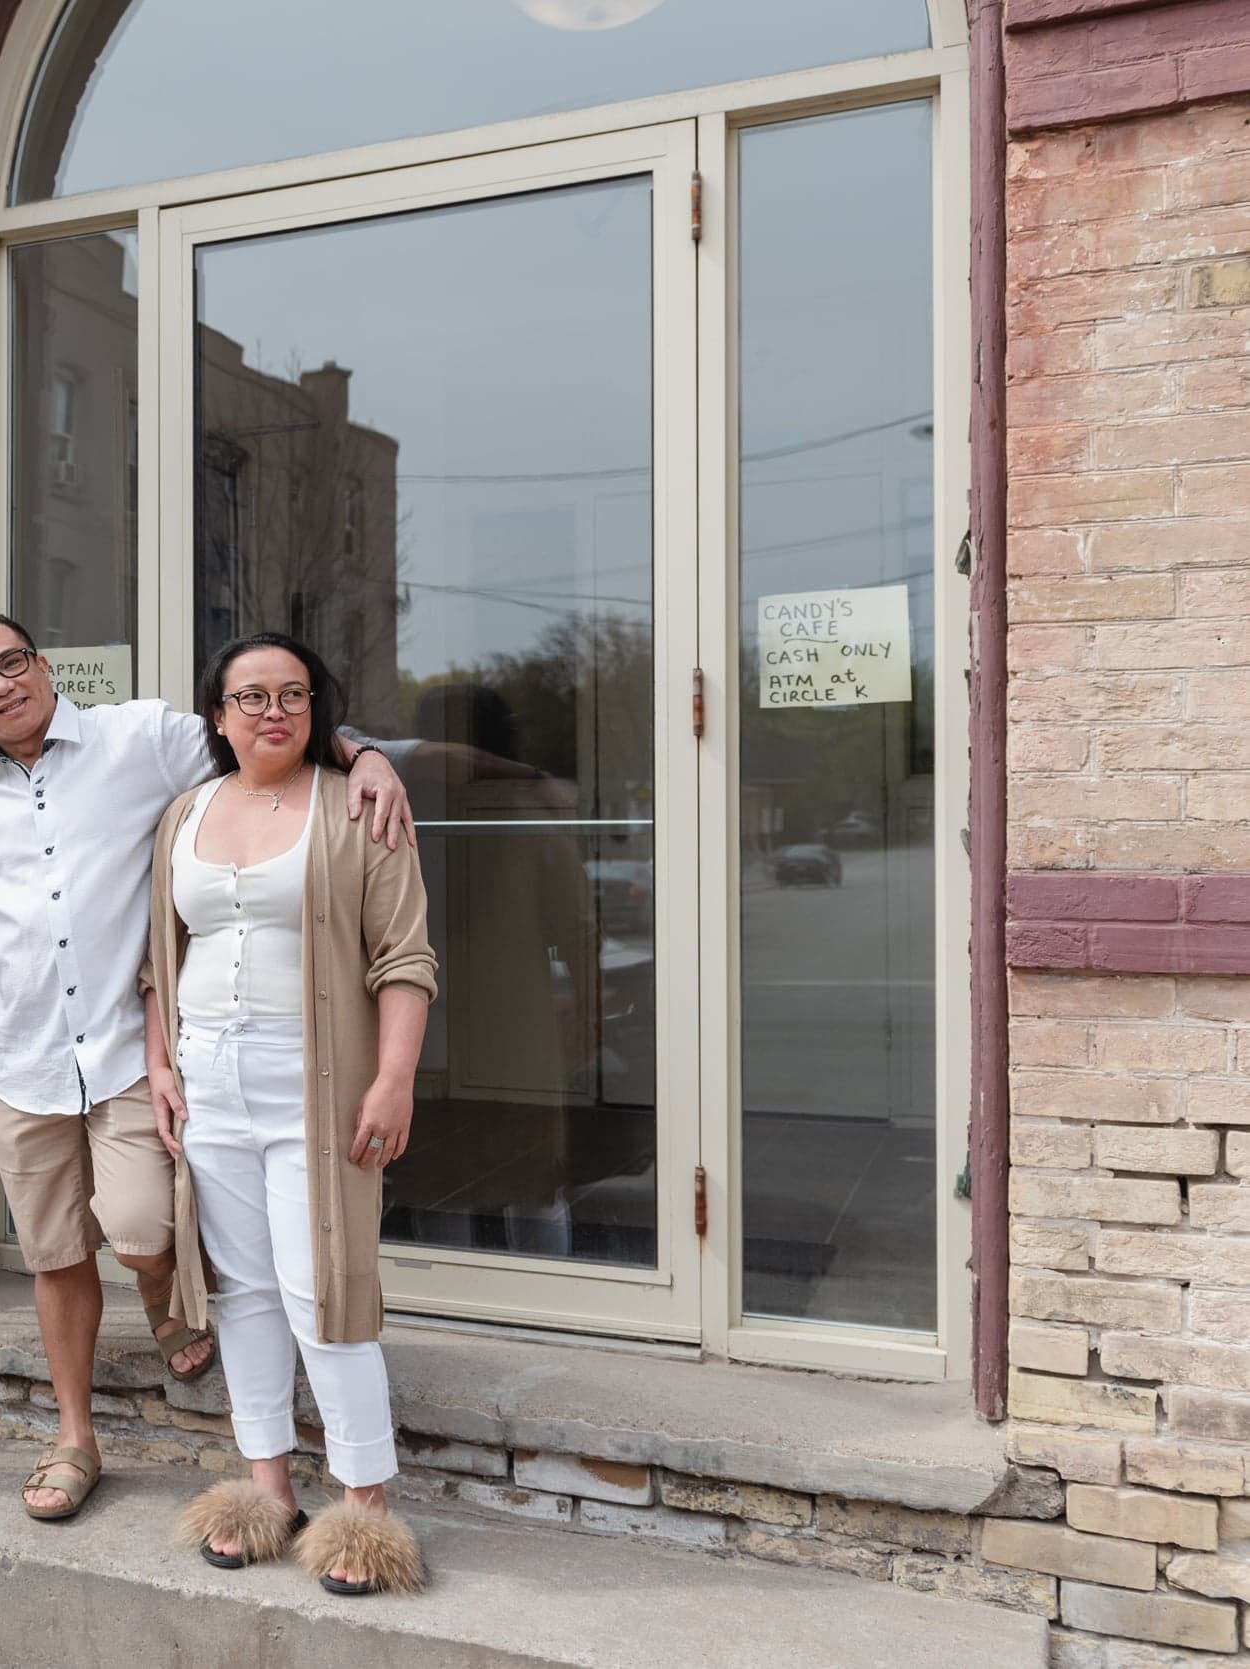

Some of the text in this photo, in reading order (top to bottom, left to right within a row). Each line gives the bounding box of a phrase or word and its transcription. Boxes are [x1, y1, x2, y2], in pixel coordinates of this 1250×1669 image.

[764, 598, 853, 620] CANDY'S
[780, 620, 838, 637] CAFE
[766, 642, 891, 665] CASH ONLY
[48, 662, 104, 676] APTAIN
[770, 669, 857, 688] ATM at
[769, 685, 869, 703] CIRCLE K
